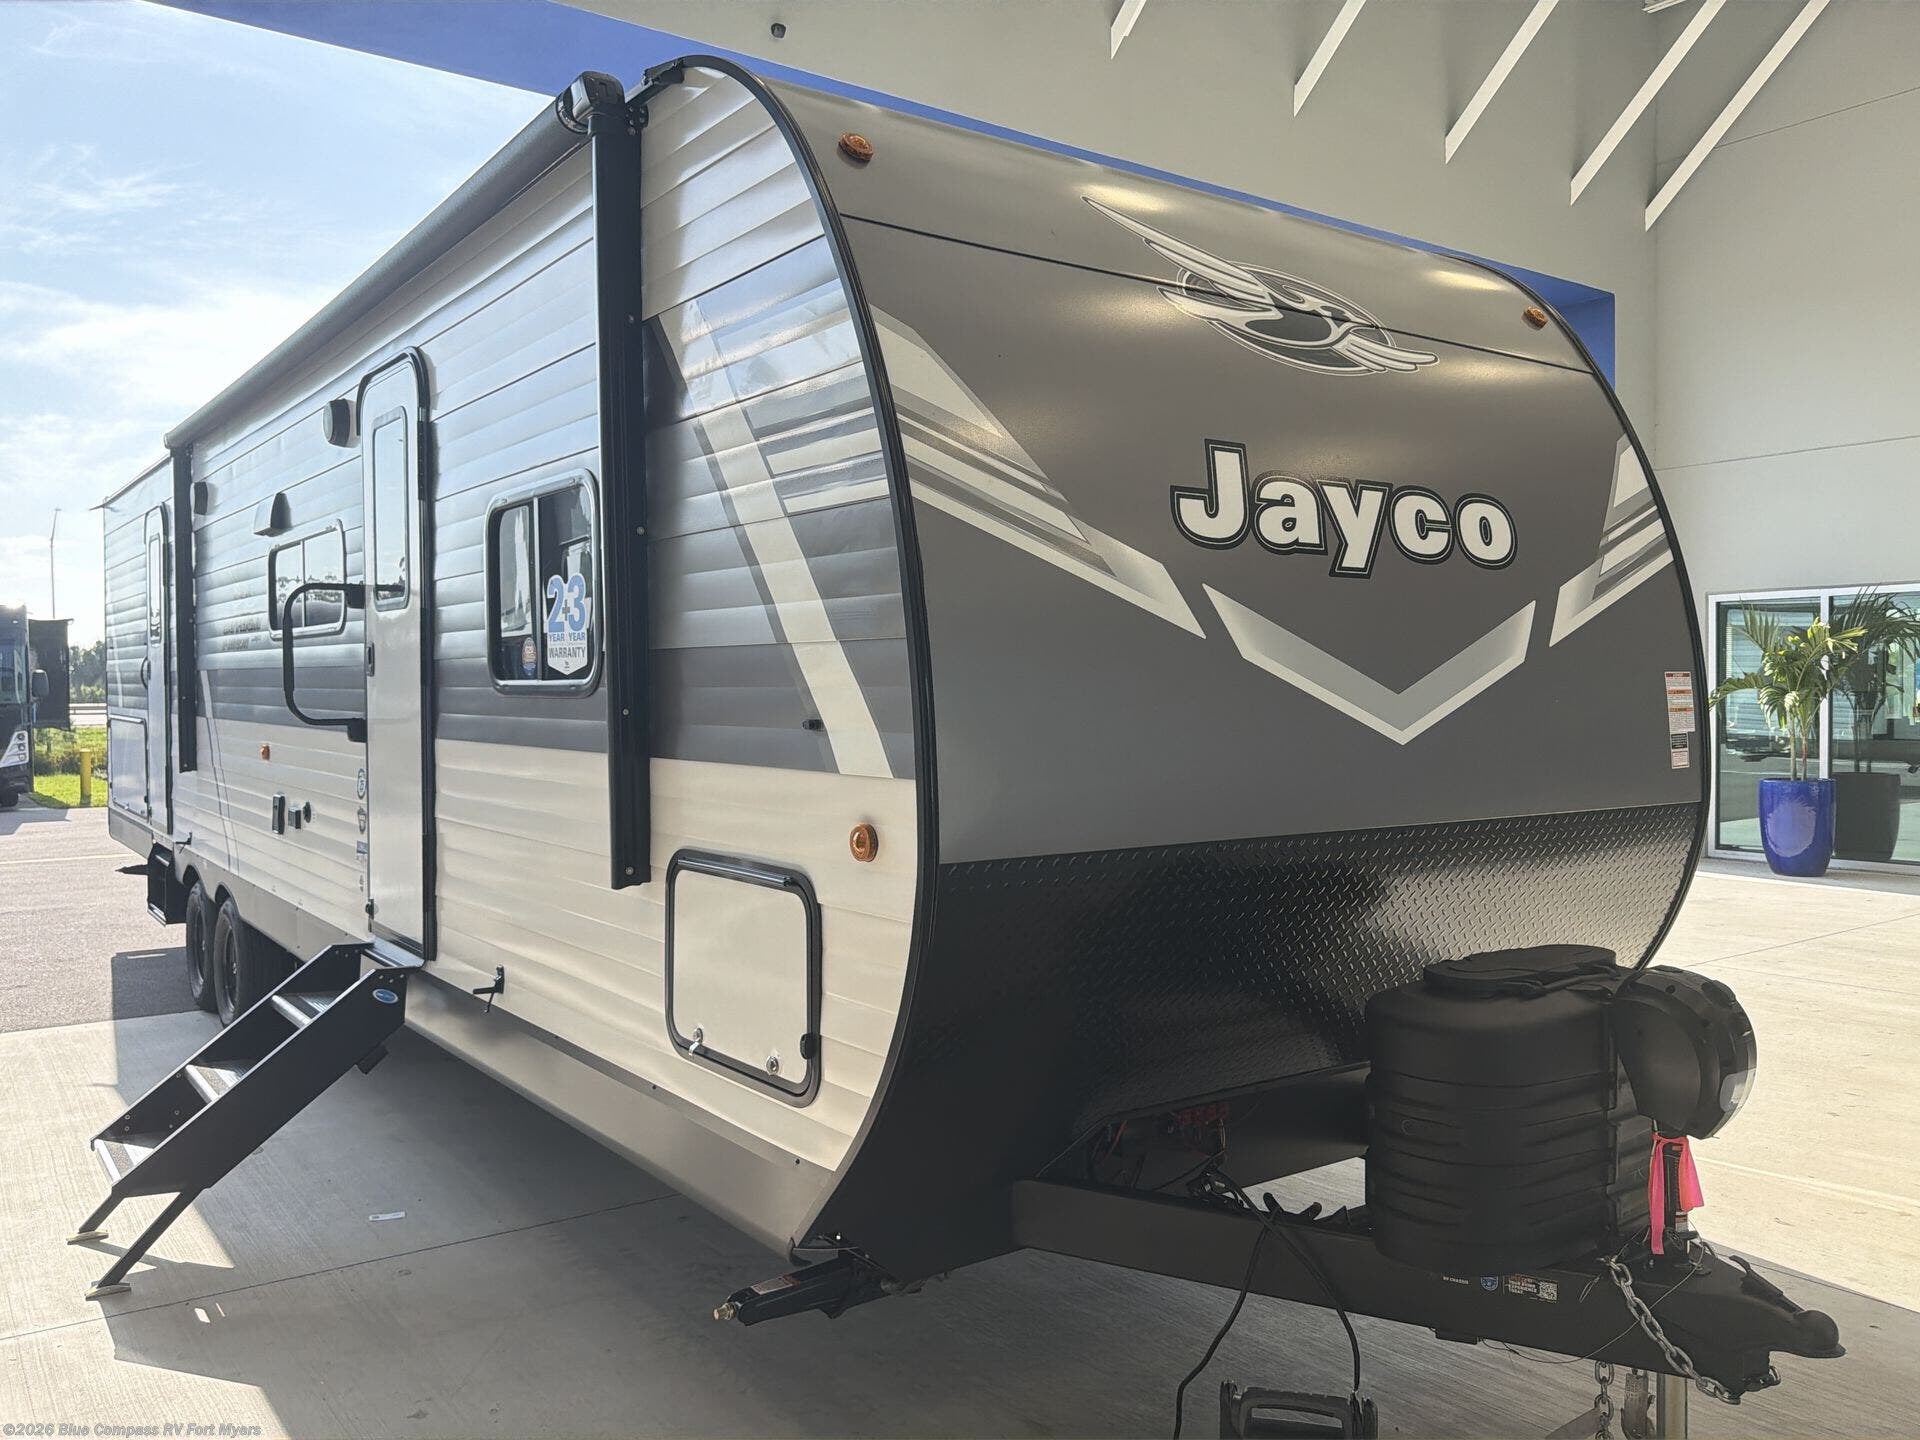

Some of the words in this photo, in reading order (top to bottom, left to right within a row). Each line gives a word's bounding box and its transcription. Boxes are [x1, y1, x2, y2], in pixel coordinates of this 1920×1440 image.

[1170, 438, 1517, 579] Jayco
[549, 632, 565, 642] YEAR
[569, 631, 585, 641] YEAR
[549, 646, 586, 659] WARRANTY
